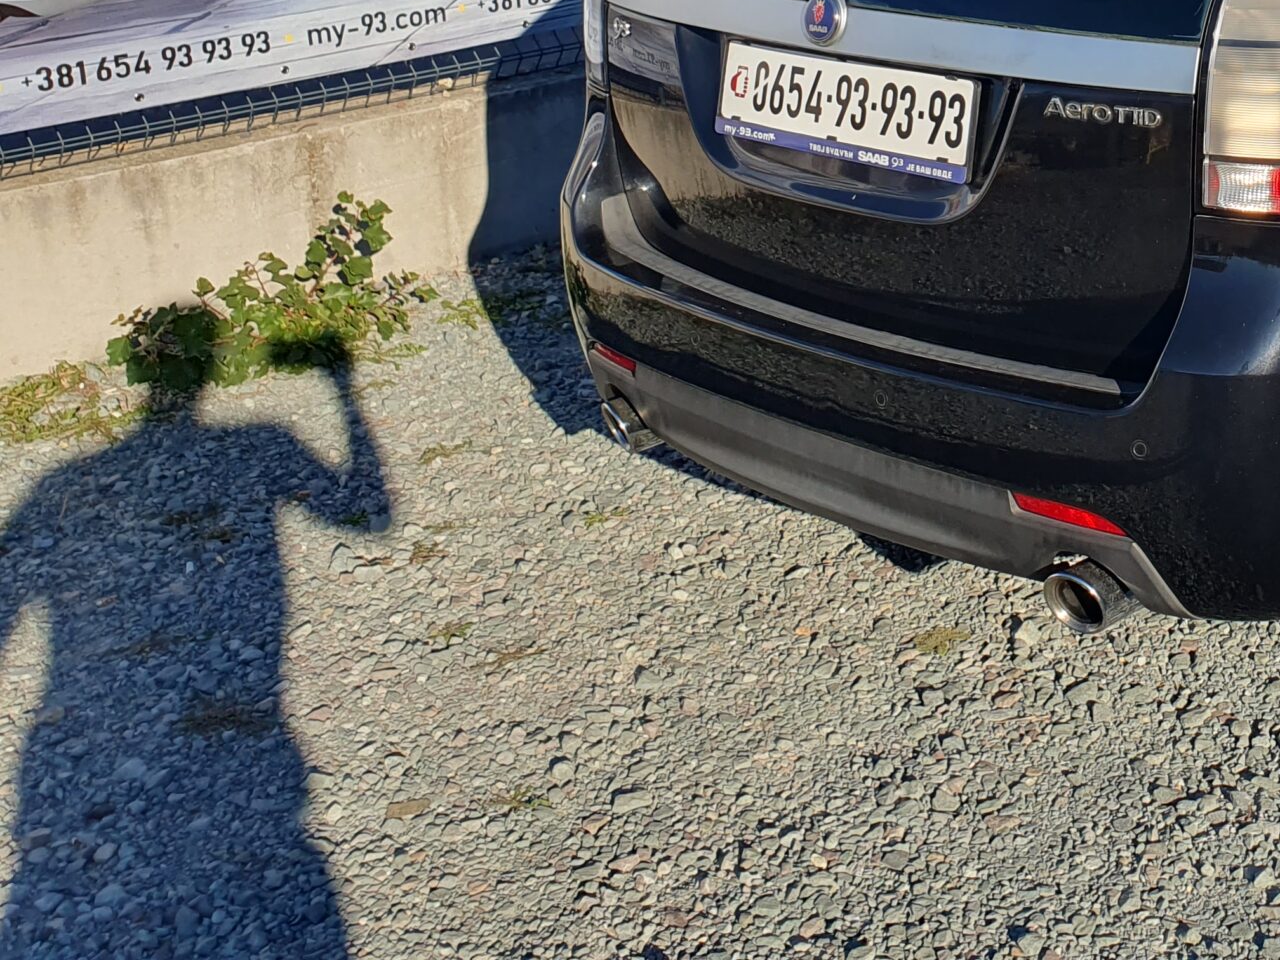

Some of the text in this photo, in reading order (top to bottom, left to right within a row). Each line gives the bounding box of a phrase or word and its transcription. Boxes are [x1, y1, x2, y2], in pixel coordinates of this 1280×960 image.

[21, 60, 87, 91] +381
[97, 50, 151, 82] 654
[161, 43, 193, 71] 93
[202, 37, 232, 64] 93
[241, 31, 271, 56] 93
[307, 6, 446, 47] my-93.com
[858, 150, 889, 166] SAAB
[891, 157, 904, 168] 93
